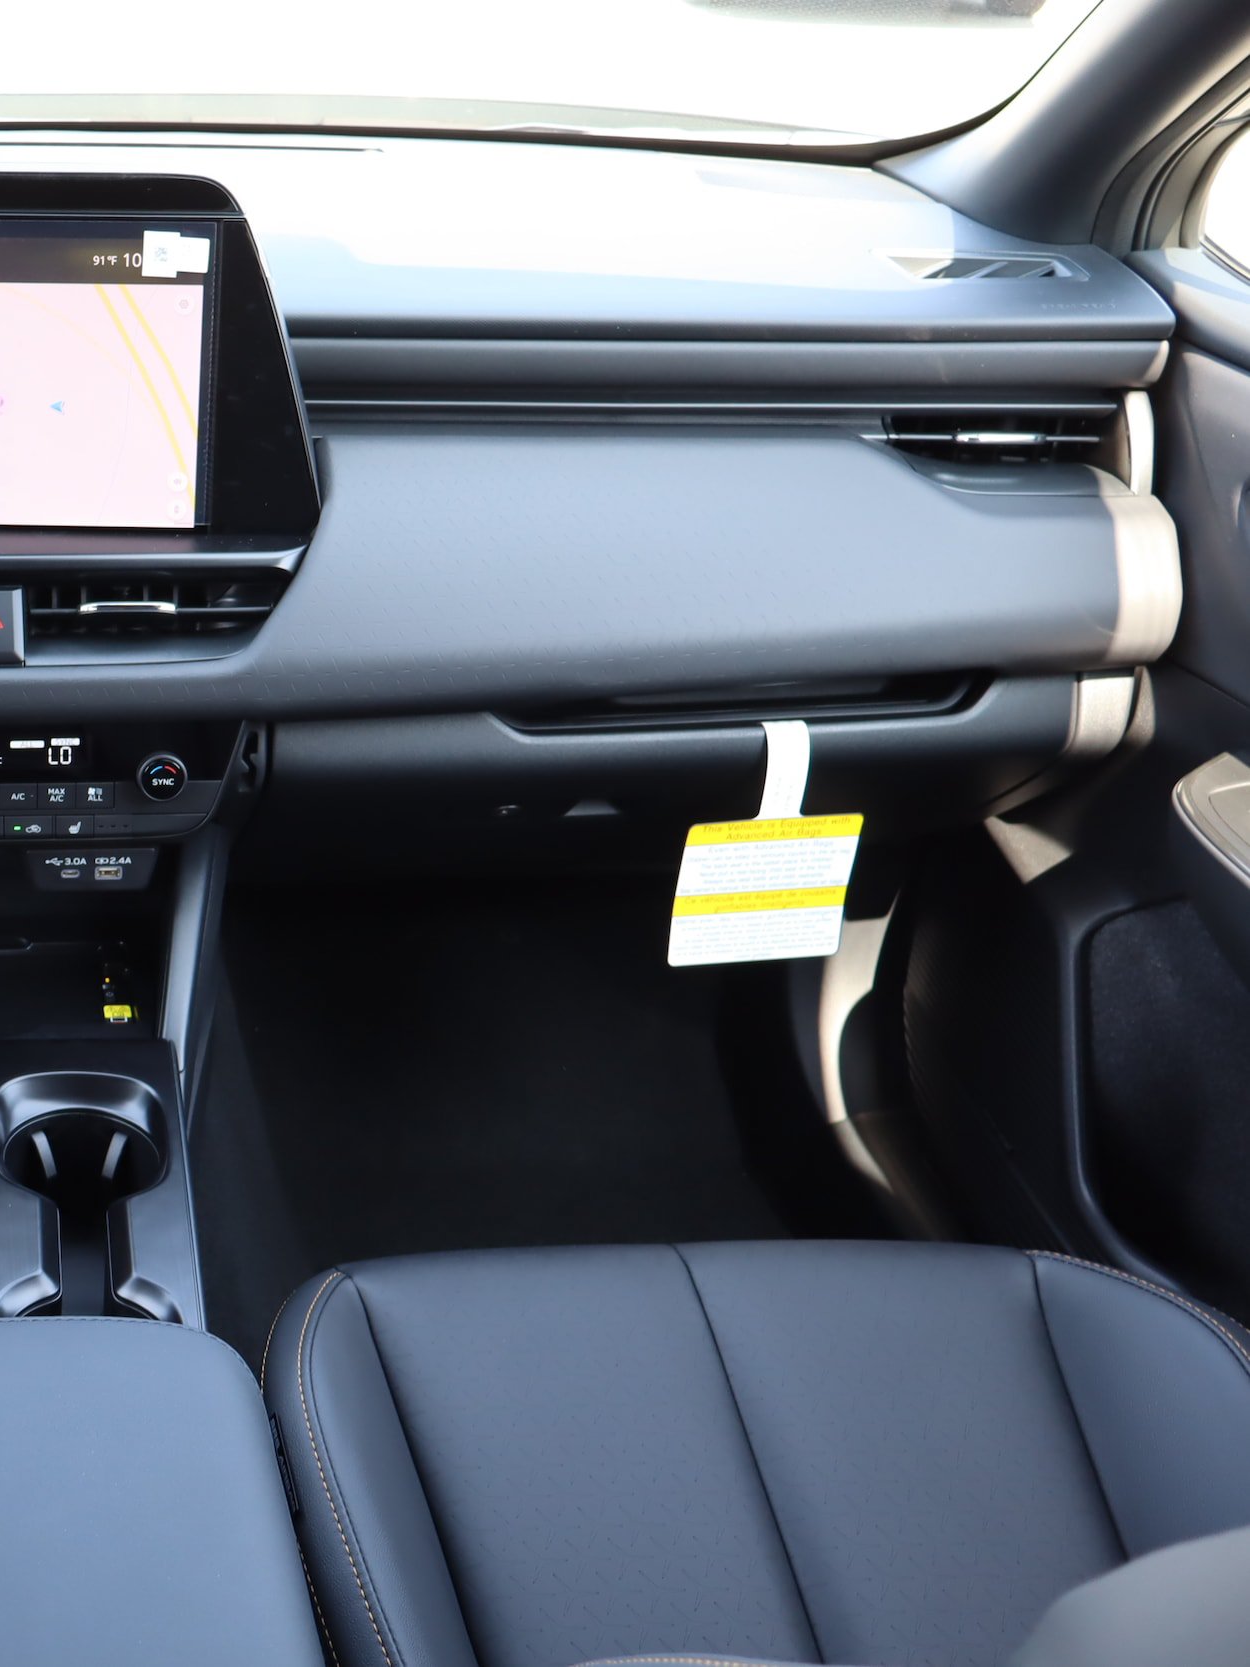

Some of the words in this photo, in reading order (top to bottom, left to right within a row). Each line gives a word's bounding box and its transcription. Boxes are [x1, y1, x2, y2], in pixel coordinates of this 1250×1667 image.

[152, 777, 175, 786] SYNC
[702, 825, 723, 833] This
[727, 822, 763, 832] Vehicle
[780, 817, 827, 830] Equipped
[831, 816, 851, 825] with
[726, 831, 775, 841] Advanced
[779, 829, 792, 837] Air
[797, 828, 822, 839] Bags
[64, 857, 87, 866] 3.0A
[109, 857, 132, 865] 2.4A
